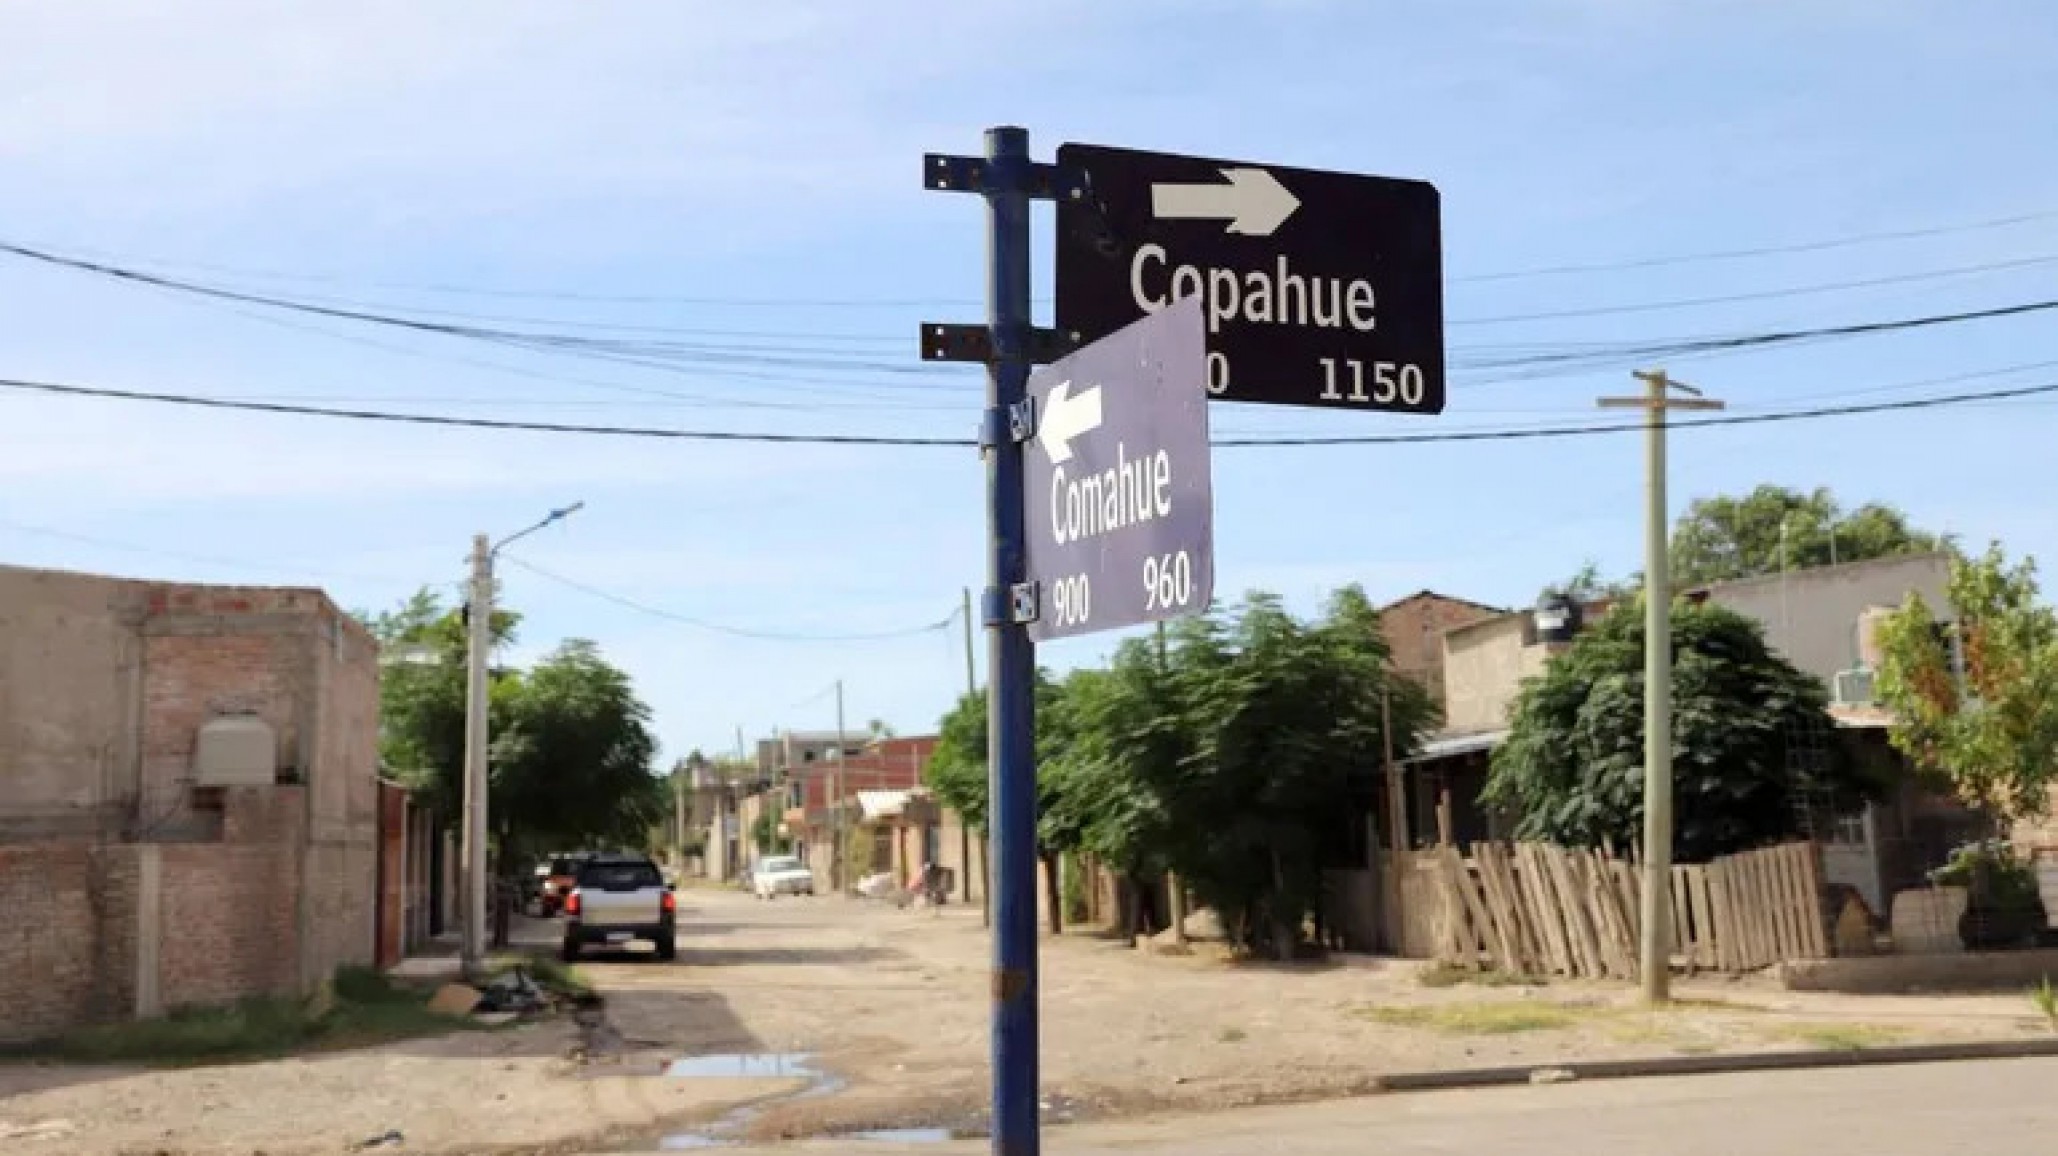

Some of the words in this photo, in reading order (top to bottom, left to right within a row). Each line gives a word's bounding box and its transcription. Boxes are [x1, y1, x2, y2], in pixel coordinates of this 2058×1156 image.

[1131, 243, 1375, 333] Copahue
[1319, 357, 1424, 405] 1150
[1053, 441, 1171, 545] Comahue
[1055, 572, 1089, 626] 900
[1144, 550, 1190, 611] 960
